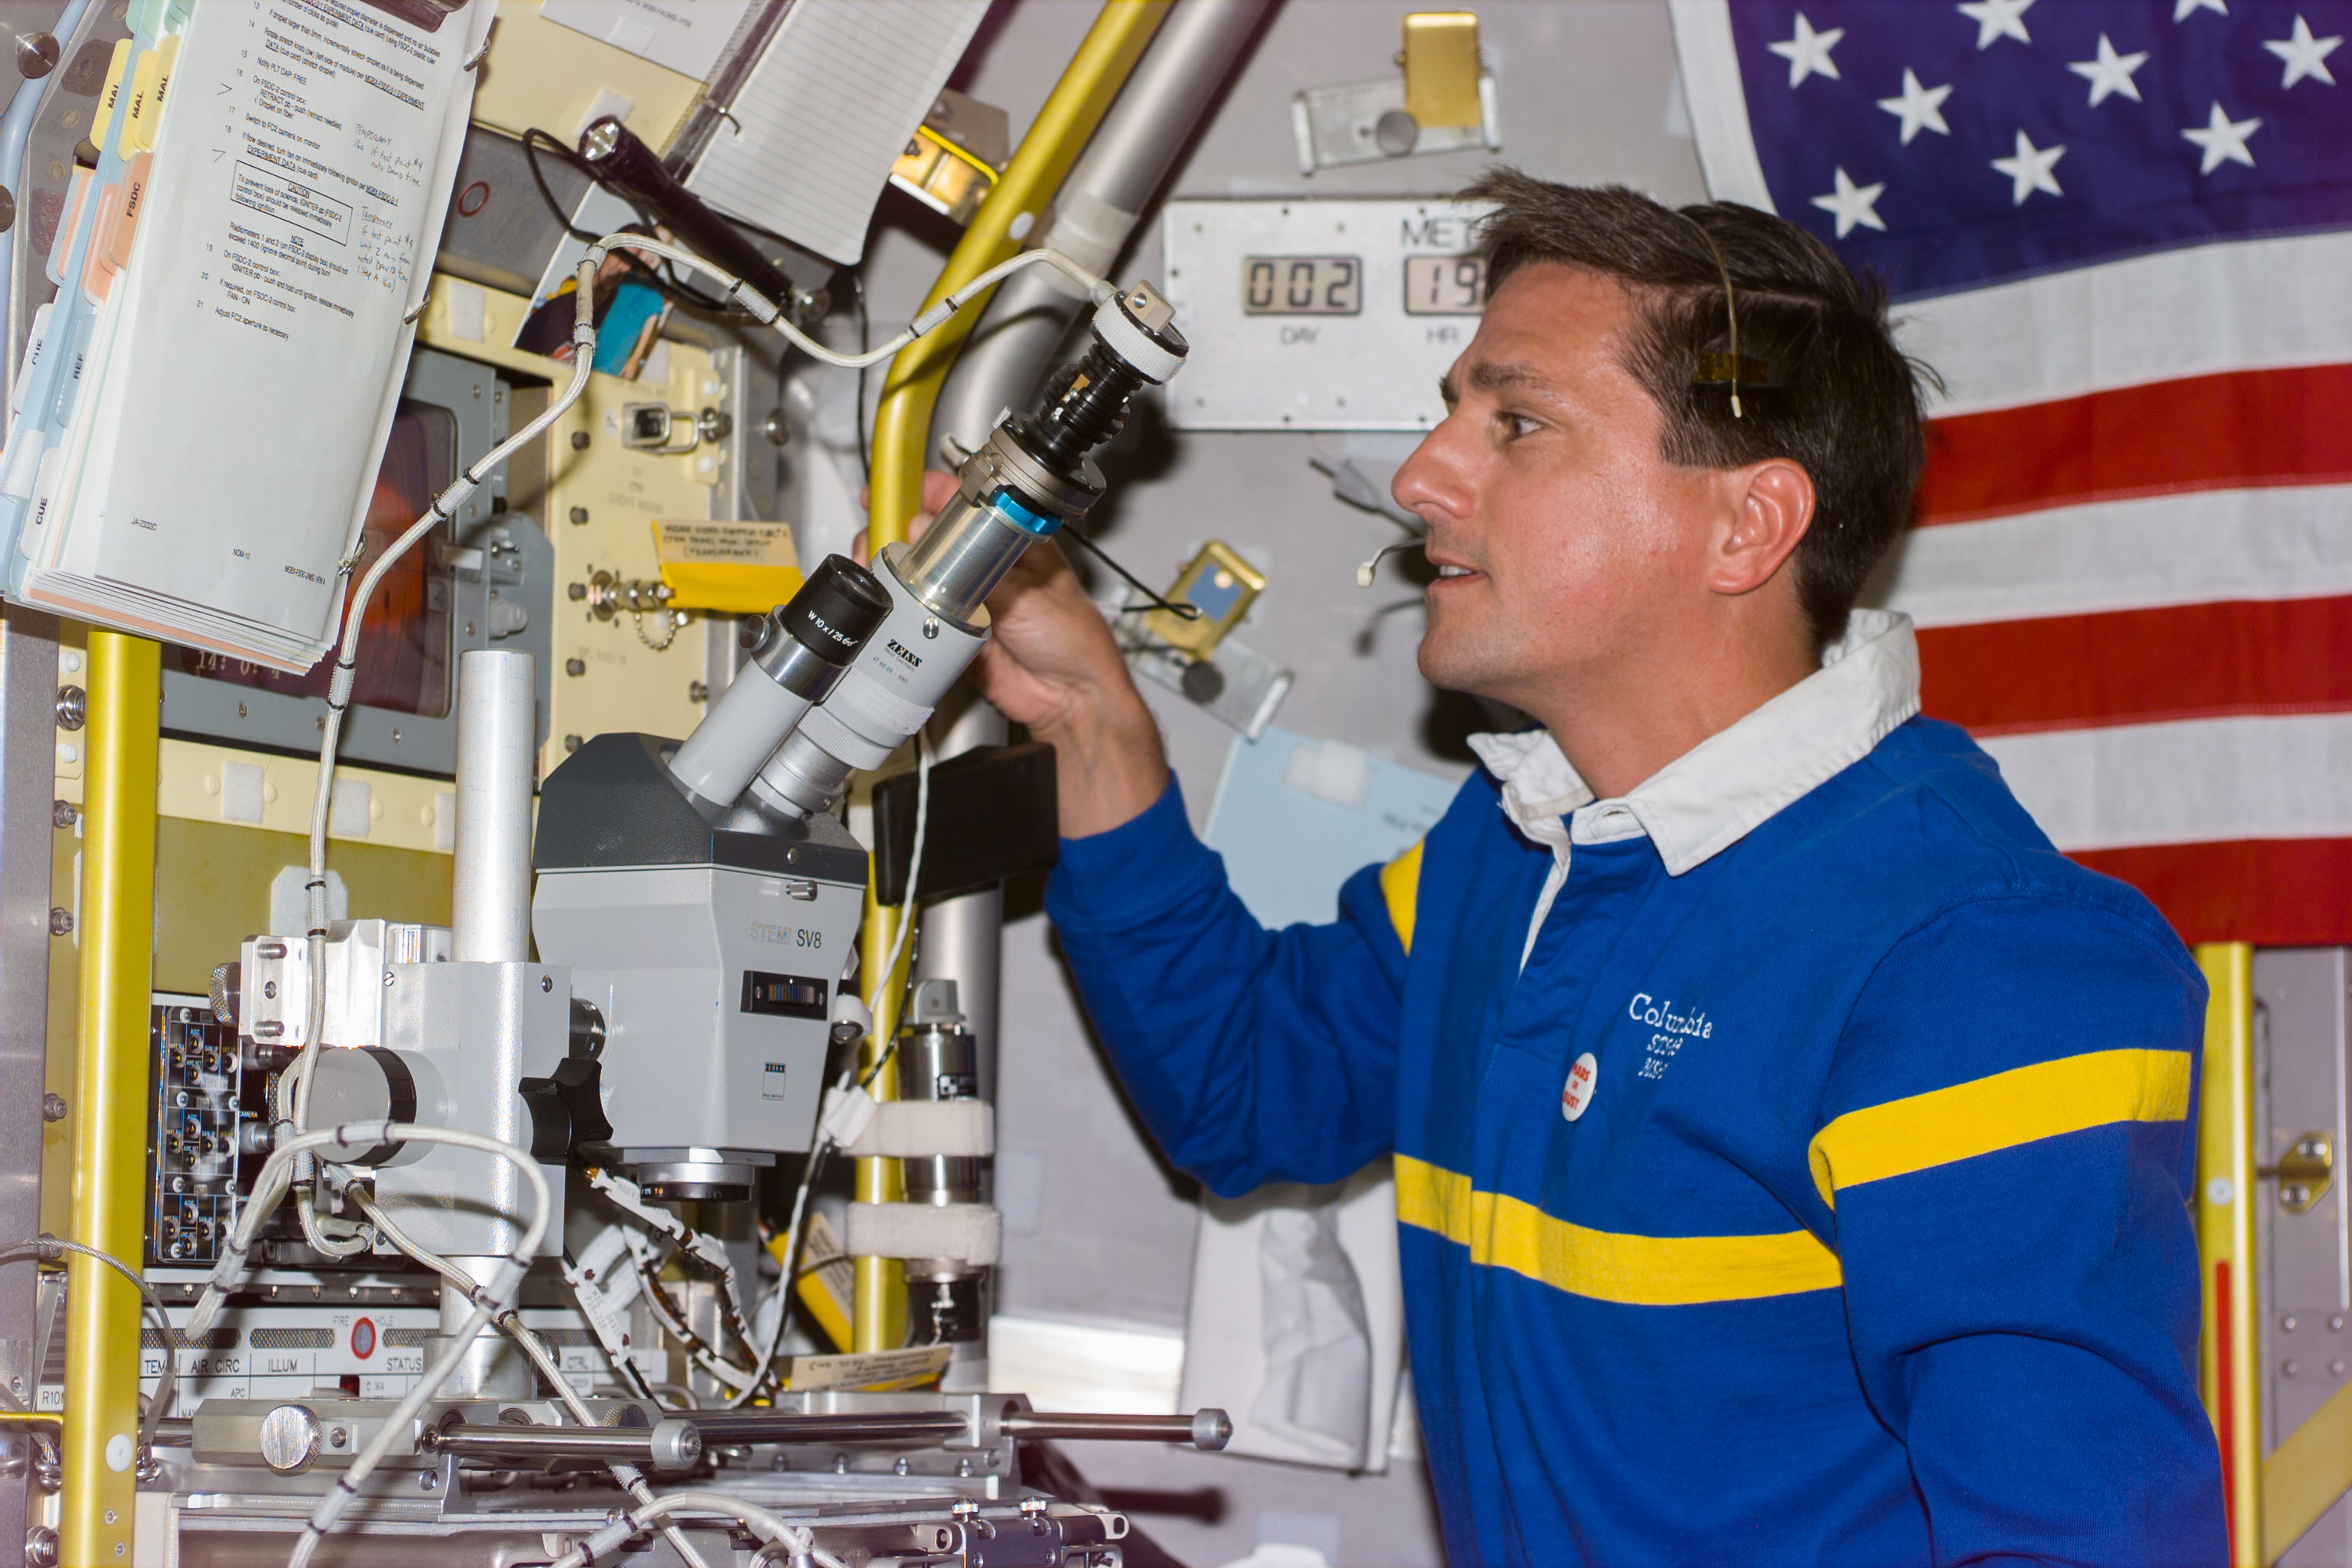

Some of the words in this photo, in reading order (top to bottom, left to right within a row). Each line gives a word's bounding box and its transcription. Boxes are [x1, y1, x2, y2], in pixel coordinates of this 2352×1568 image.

[266, 38, 279, 52] DATA
[253, 75, 260, 85] On
[156, 74, 170, 103] MAL
[131, 91, 145, 120] MAL
[281, 158, 296, 171] DATA
[287, 182, 310, 198] CAUTION
[125, 181, 141, 218] FSDC
[291, 234, 304, 247] NOTE
[1247, 261, 1354, 307] 002
[1430, 263, 1480, 307] 19
[227, 290, 238, 301] FAN
[241, 295, 251, 305] ON
[1279, 326, 1321, 345] DAY
[1426, 327, 1459, 344] HR
[35, 497, 48, 526] CUE
[832, 630, 843, 642] 25
[886, 638, 922, 668] ZEISS
[797, 929, 822, 949] SV8
[1629, 992, 1713, 1039] Columbia
[765, 1062, 786, 1074] ZEISS
[1570, 1061, 1591, 1083] MARS
[1562, 1090, 1580, 1111] BUST
[145, 1359, 166, 1374] TEM
[191, 1358, 208, 1374] AIR
[215, 1358, 241, 1374] CIRC
[267, 1358, 298, 1373] ILLUM
[386, 1357, 422, 1372] STATUS
[231, 1387, 246, 1398] APC
